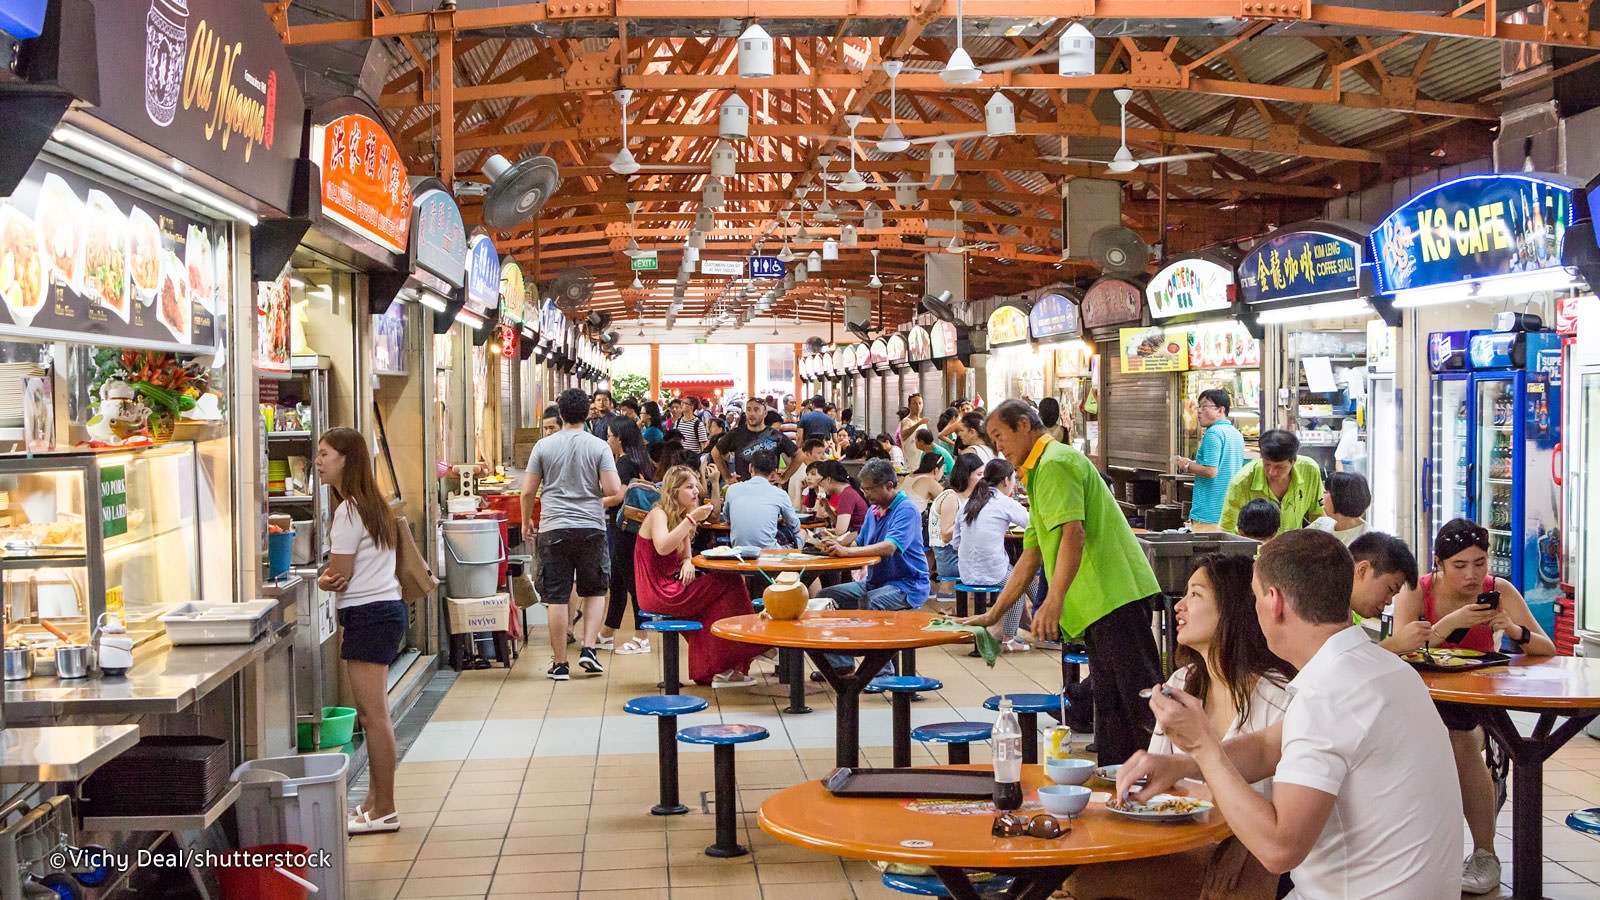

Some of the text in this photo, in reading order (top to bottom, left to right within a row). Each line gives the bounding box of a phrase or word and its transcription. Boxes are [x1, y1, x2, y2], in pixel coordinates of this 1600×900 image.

[183, 19, 220, 112] Old
[205, 42, 266, 163] Nyonya
[1418, 201, 1508, 263] K3 CAFE
[1314, 241, 1341, 259] KIM LENG
[636, 258, 652, 268] EXIT
[1316, 257, 1354, 276] COFFEE STALL
[1542, 356, 1562, 366] SUPE
[1541, 366, 1561, 378] COL
[101, 479, 126, 496] NO PORK
[102, 504, 126, 521] NO LARD
[468, 617, 496, 626] DASANI
